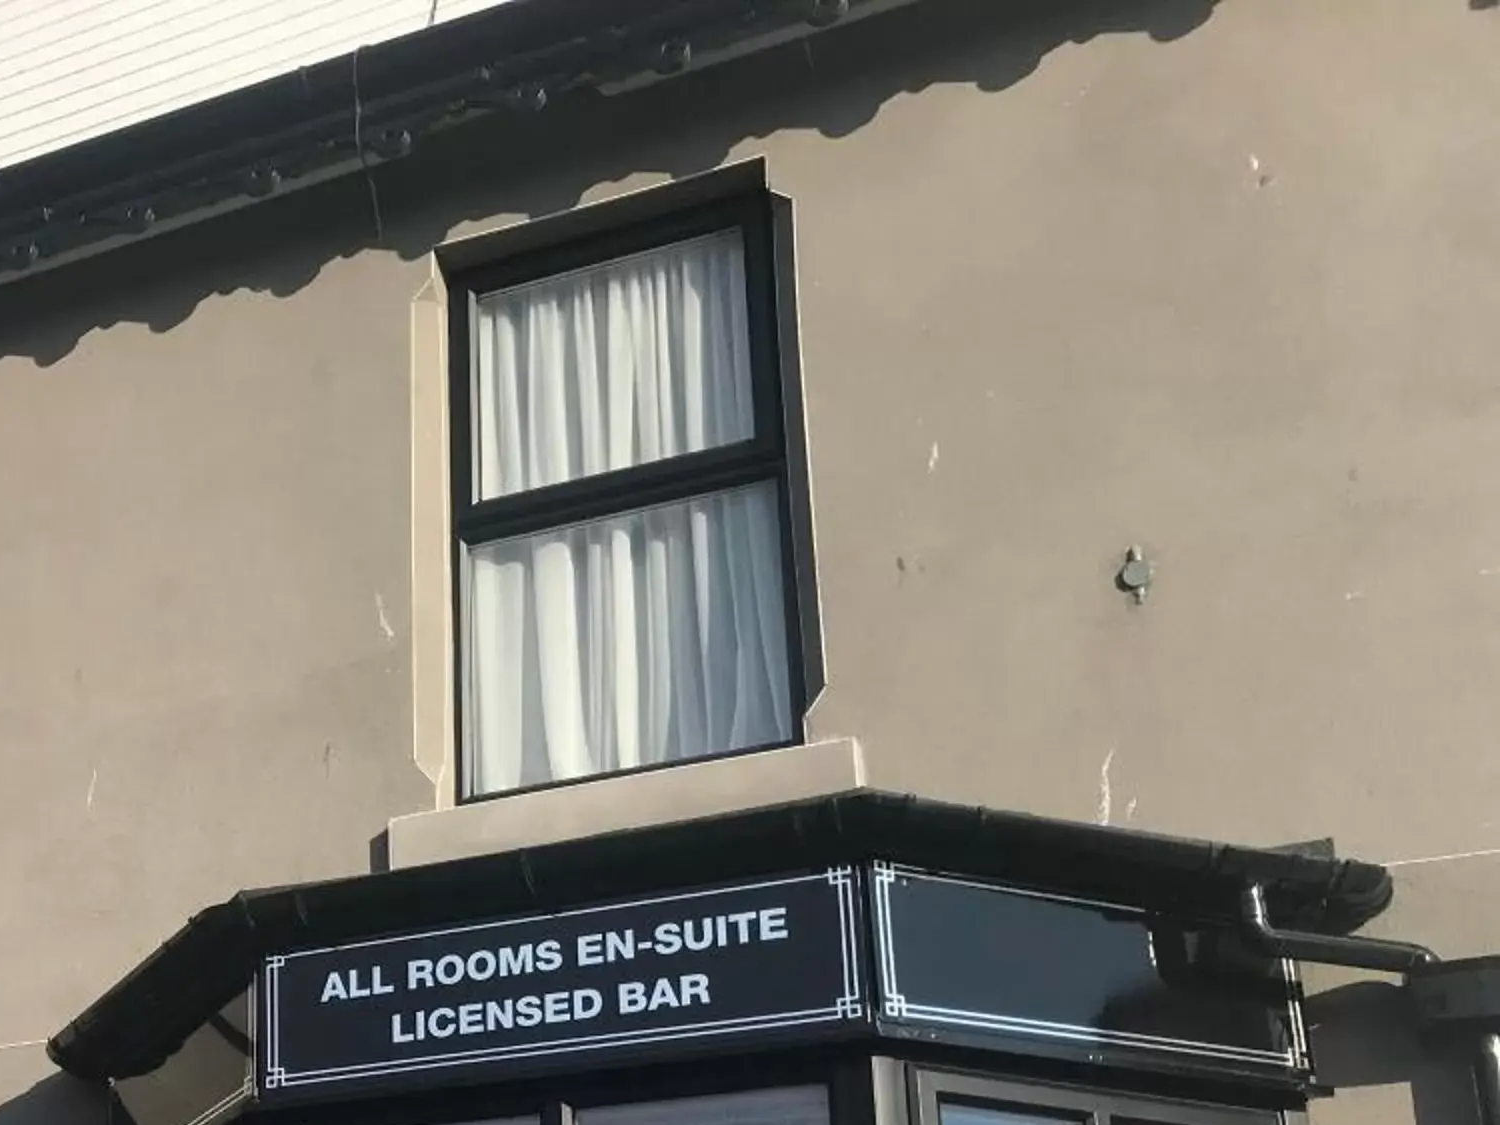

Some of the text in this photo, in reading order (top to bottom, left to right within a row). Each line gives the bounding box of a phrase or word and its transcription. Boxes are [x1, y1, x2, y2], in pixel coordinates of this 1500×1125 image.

[320, 907, 789, 1003] ALL ROOMS EN-SUITE
[391, 974, 712, 1044] LICENSED BAR
